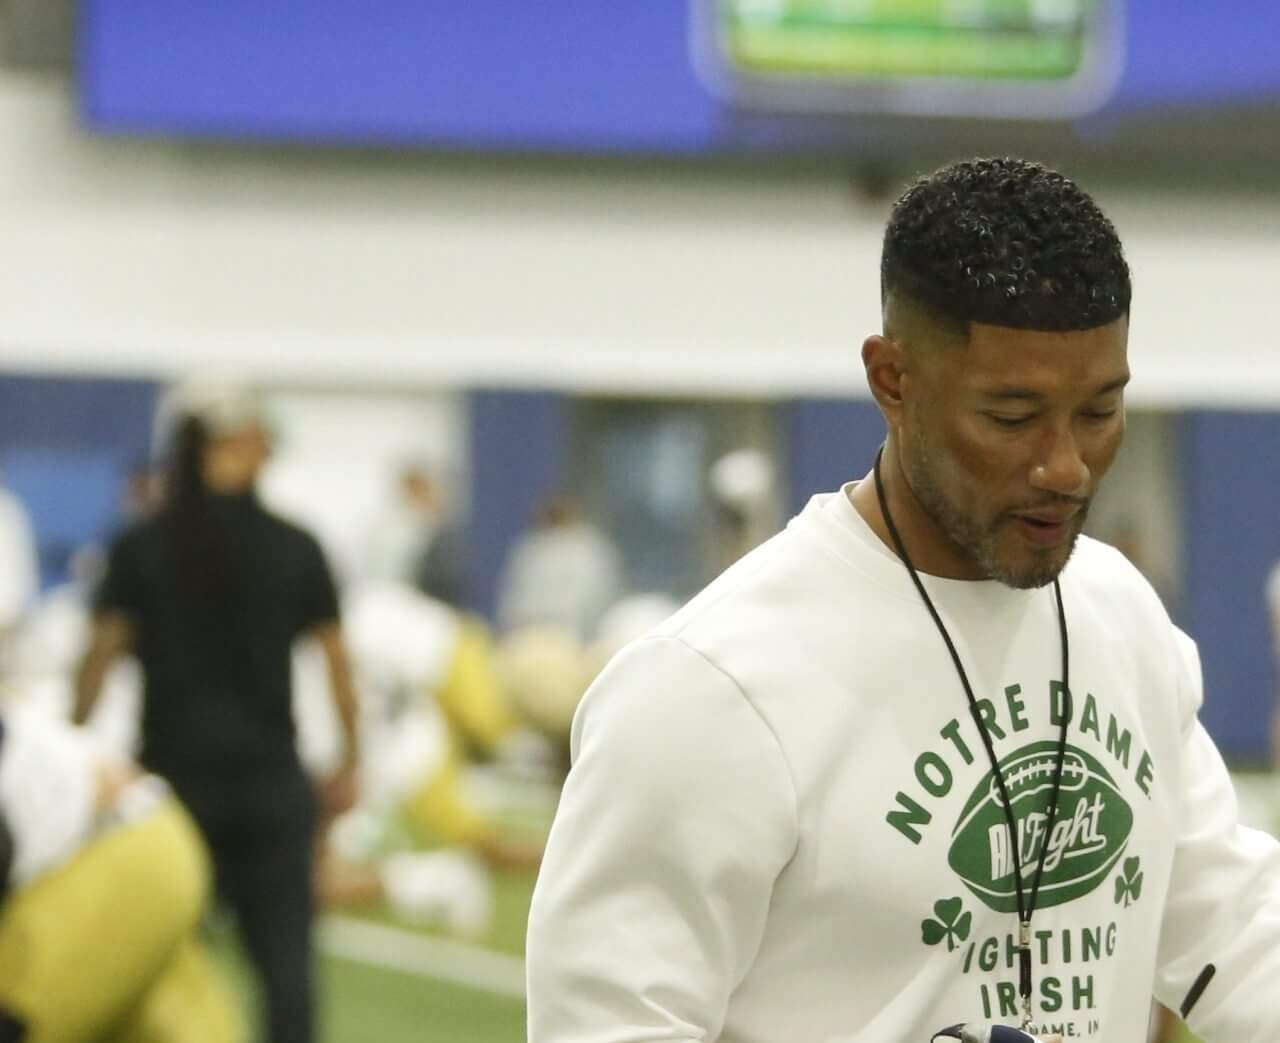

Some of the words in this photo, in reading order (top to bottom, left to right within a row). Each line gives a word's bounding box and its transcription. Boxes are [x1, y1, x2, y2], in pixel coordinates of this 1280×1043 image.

[885, 682, 1029, 845] NOTRE
[1049, 680, 1153, 797] DAME
[962, 921, 1117, 974] IGHTING
[980, 974, 1094, 1019] IRSH
